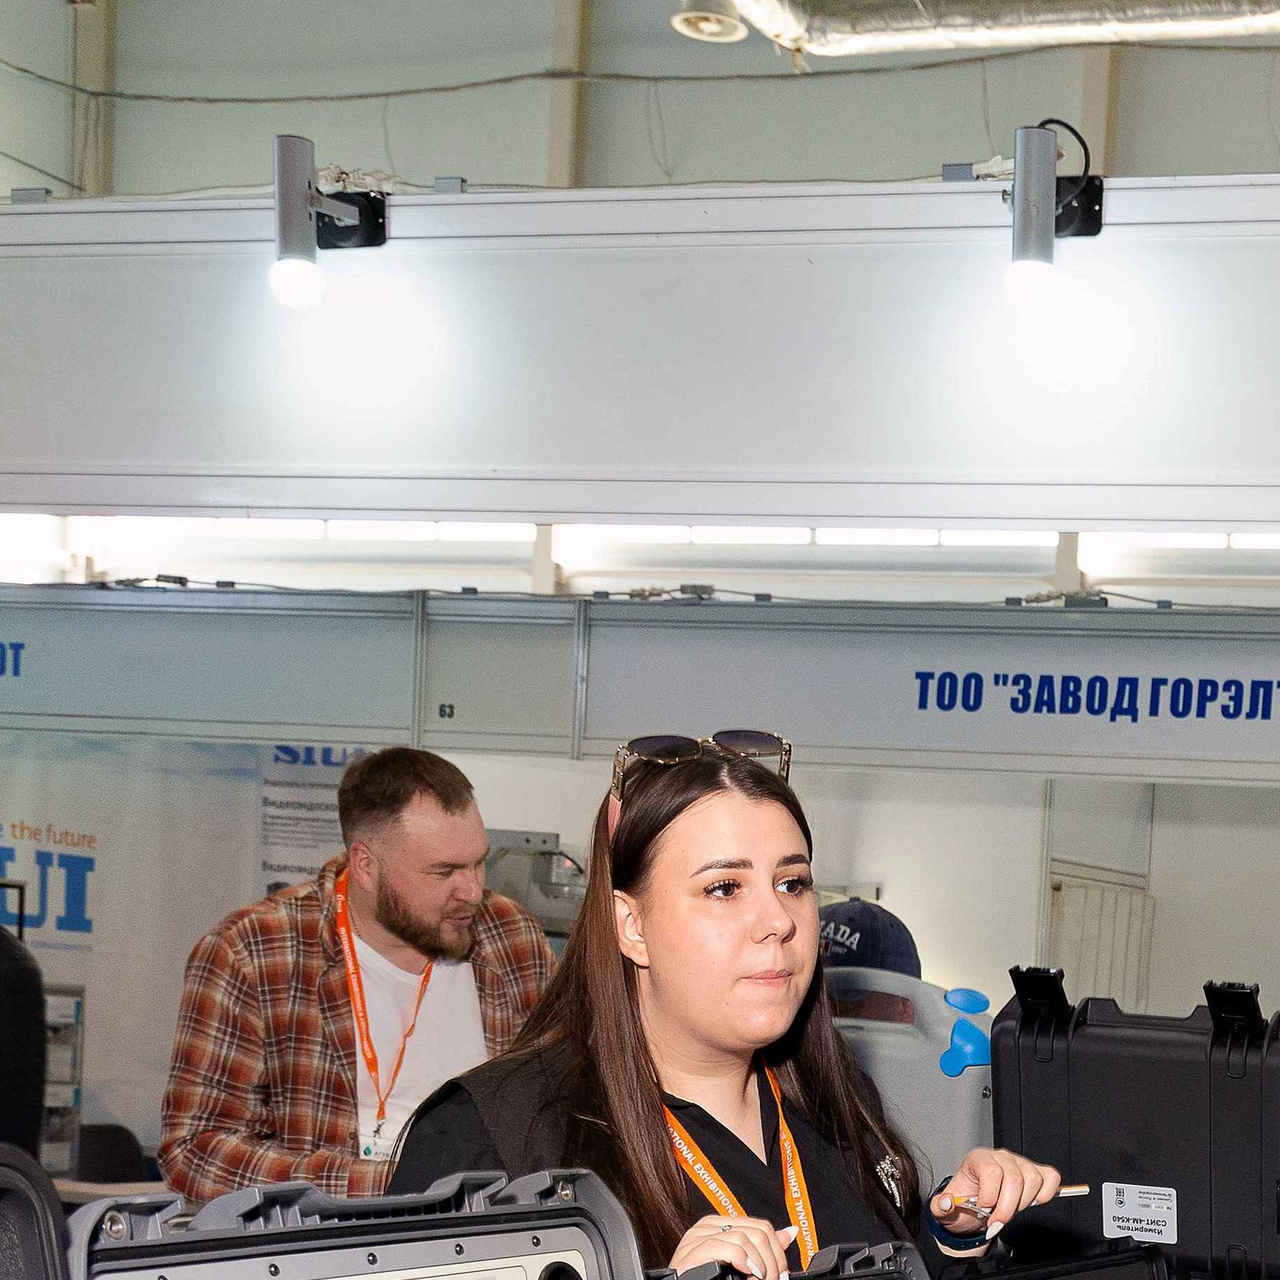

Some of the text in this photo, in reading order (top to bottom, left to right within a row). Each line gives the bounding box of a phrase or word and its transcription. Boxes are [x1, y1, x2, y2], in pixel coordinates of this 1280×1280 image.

[438, 703, 455, 719] 63
[915, 671, 983, 712] ТОО
[993, 673, 1140, 722] "ЗАВОД
[10, 819, 97, 850] the future
[783, 1141, 801, 1198] EXHIBITIONS
[694, 1163, 738, 1218] EXHIBITIONS
[1116, 1225, 1163, 1236] Измеритель
